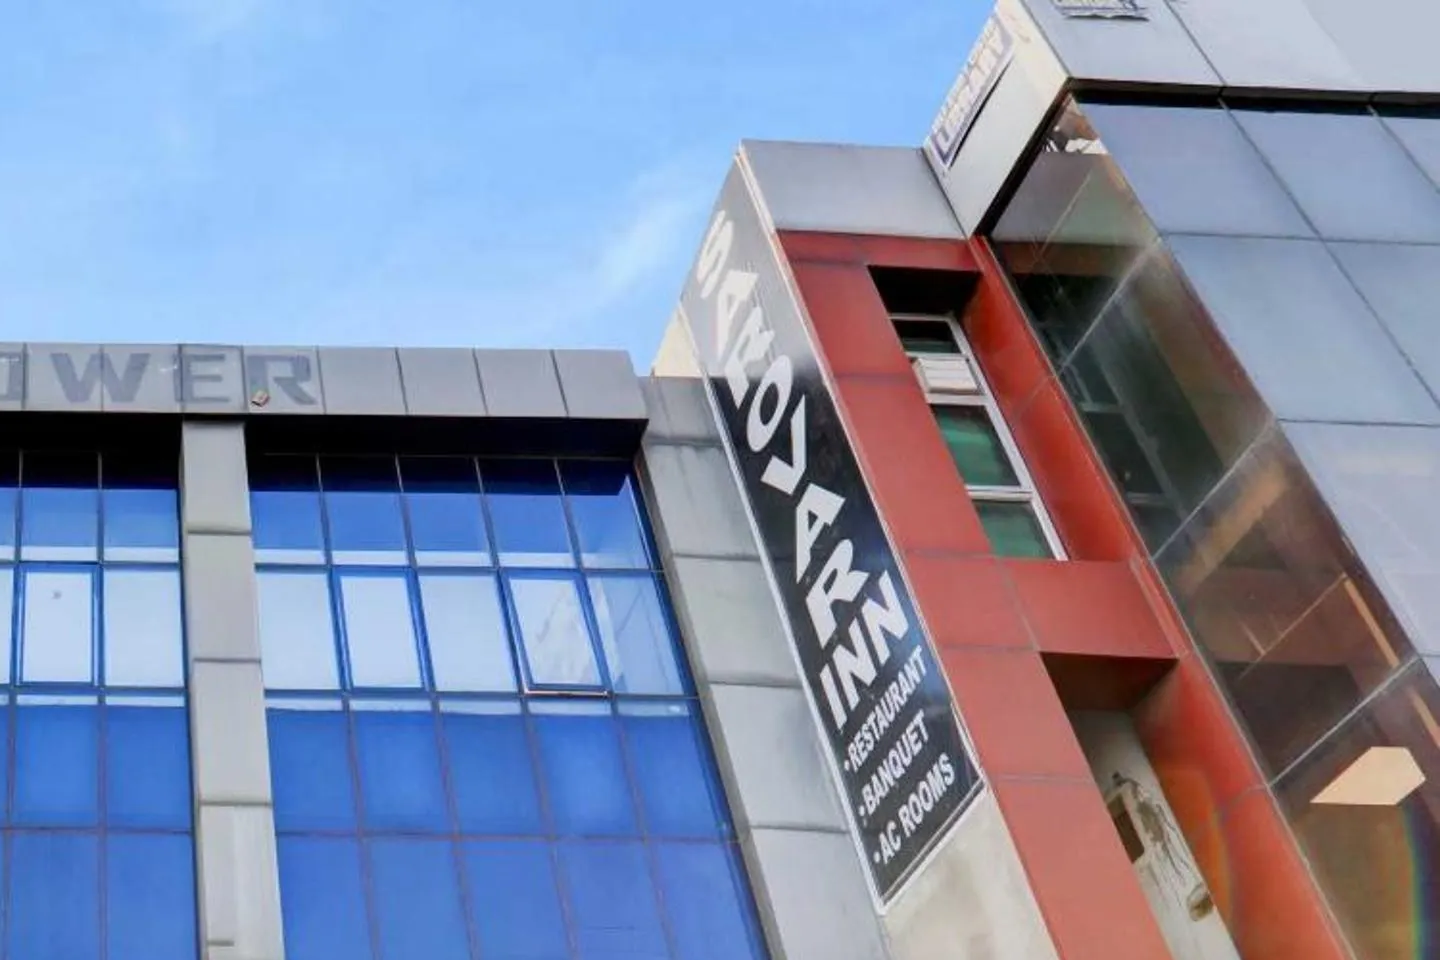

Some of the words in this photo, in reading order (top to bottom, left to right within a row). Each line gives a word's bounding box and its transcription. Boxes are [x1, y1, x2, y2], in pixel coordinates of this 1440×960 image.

[696, 210, 869, 648] SAROVAR
[820, 569, 909, 729] INN
[848, 645, 927, 773] RESTAURANT
[862, 711, 929, 817] BANQUET
[879, 822, 901, 865] AC
[898, 752, 955, 838] ROOMS
